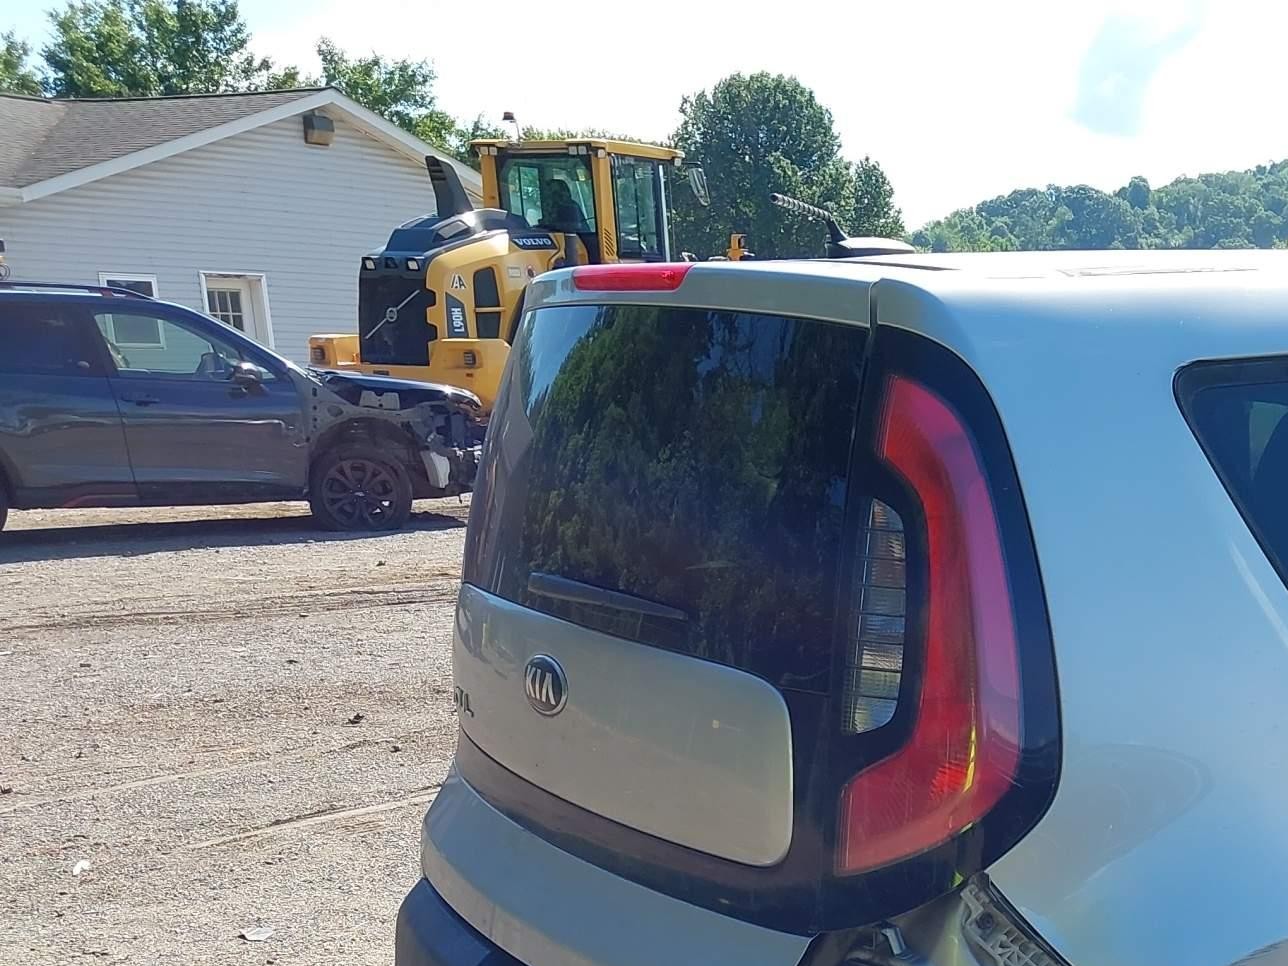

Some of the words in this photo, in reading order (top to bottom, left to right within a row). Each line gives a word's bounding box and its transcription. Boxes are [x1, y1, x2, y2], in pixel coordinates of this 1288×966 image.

[512, 238, 552, 246] VOLVO
[451, 307, 465, 333] L90H
[525, 664, 556, 706] KIA
